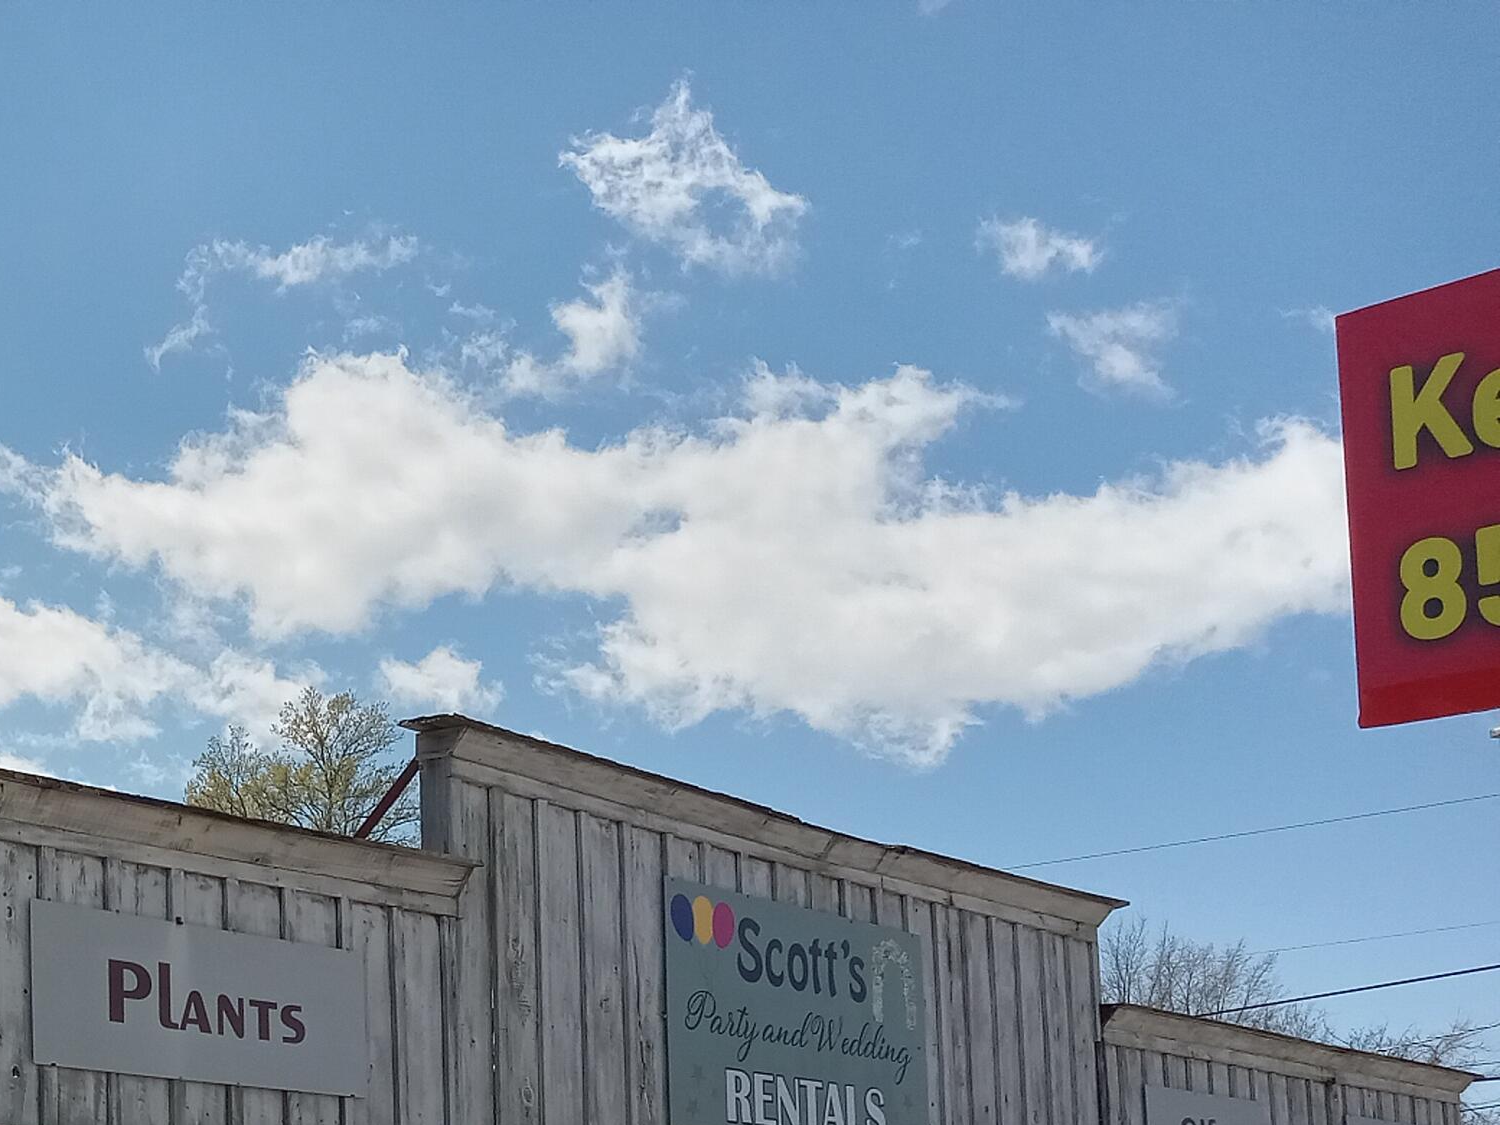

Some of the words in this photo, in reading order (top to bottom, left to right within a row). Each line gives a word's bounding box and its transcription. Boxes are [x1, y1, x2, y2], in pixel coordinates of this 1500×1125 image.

[737, 917, 868, 1003] Scott's
[685, 990, 758, 1062] Party
[760, 1011, 811, 1050] and
[809, 1014, 913, 1085] Wedding
